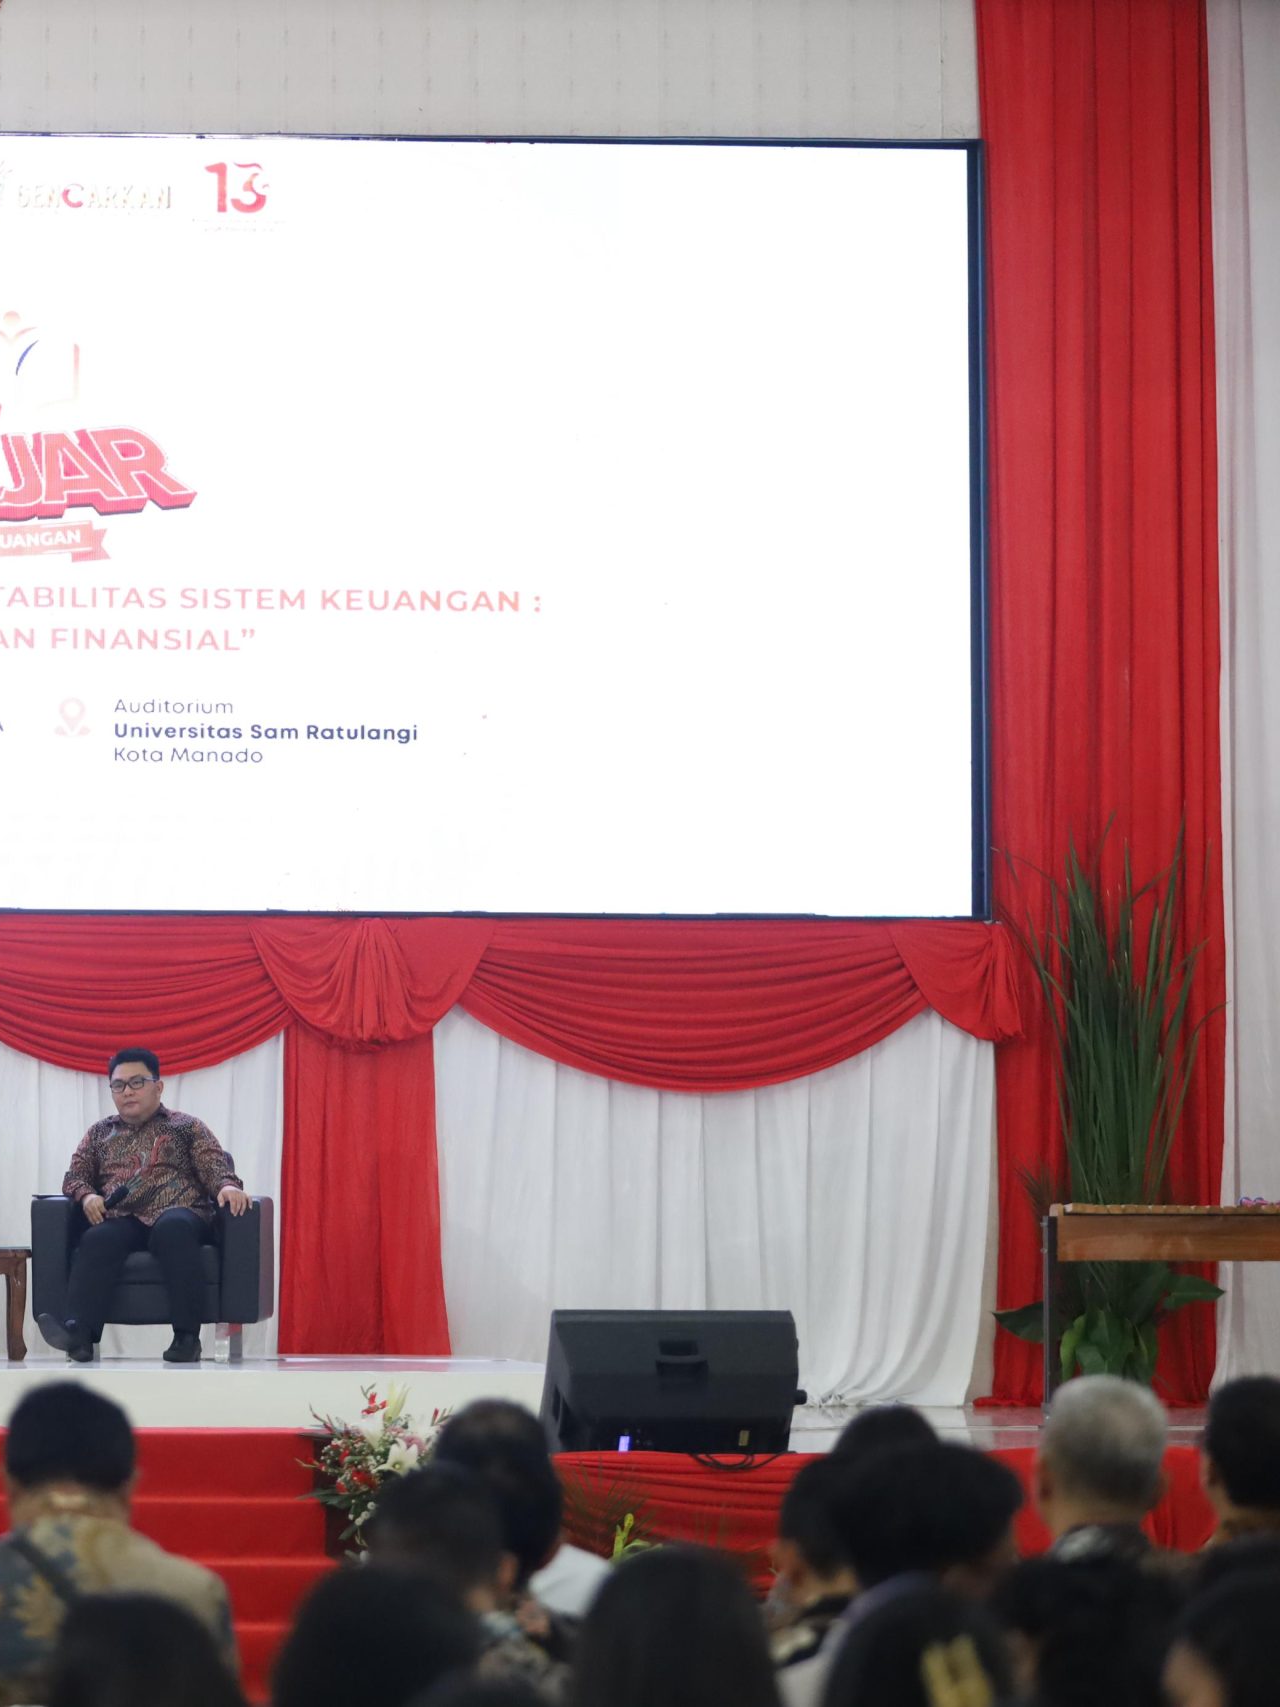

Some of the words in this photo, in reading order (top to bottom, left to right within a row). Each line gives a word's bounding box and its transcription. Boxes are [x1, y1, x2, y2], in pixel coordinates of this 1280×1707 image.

[180, 588, 306, 610] SISTEM
[320, 589, 520, 612] KEUANGAN
[113, 698, 234, 715] Auditorium
[113, 722, 243, 739] Universitas
[249, 724, 299, 740] Sam
[306, 724, 419, 744] Ratulangi
[113, 747, 164, 763] Kota
[170, 747, 264, 764] Manado
